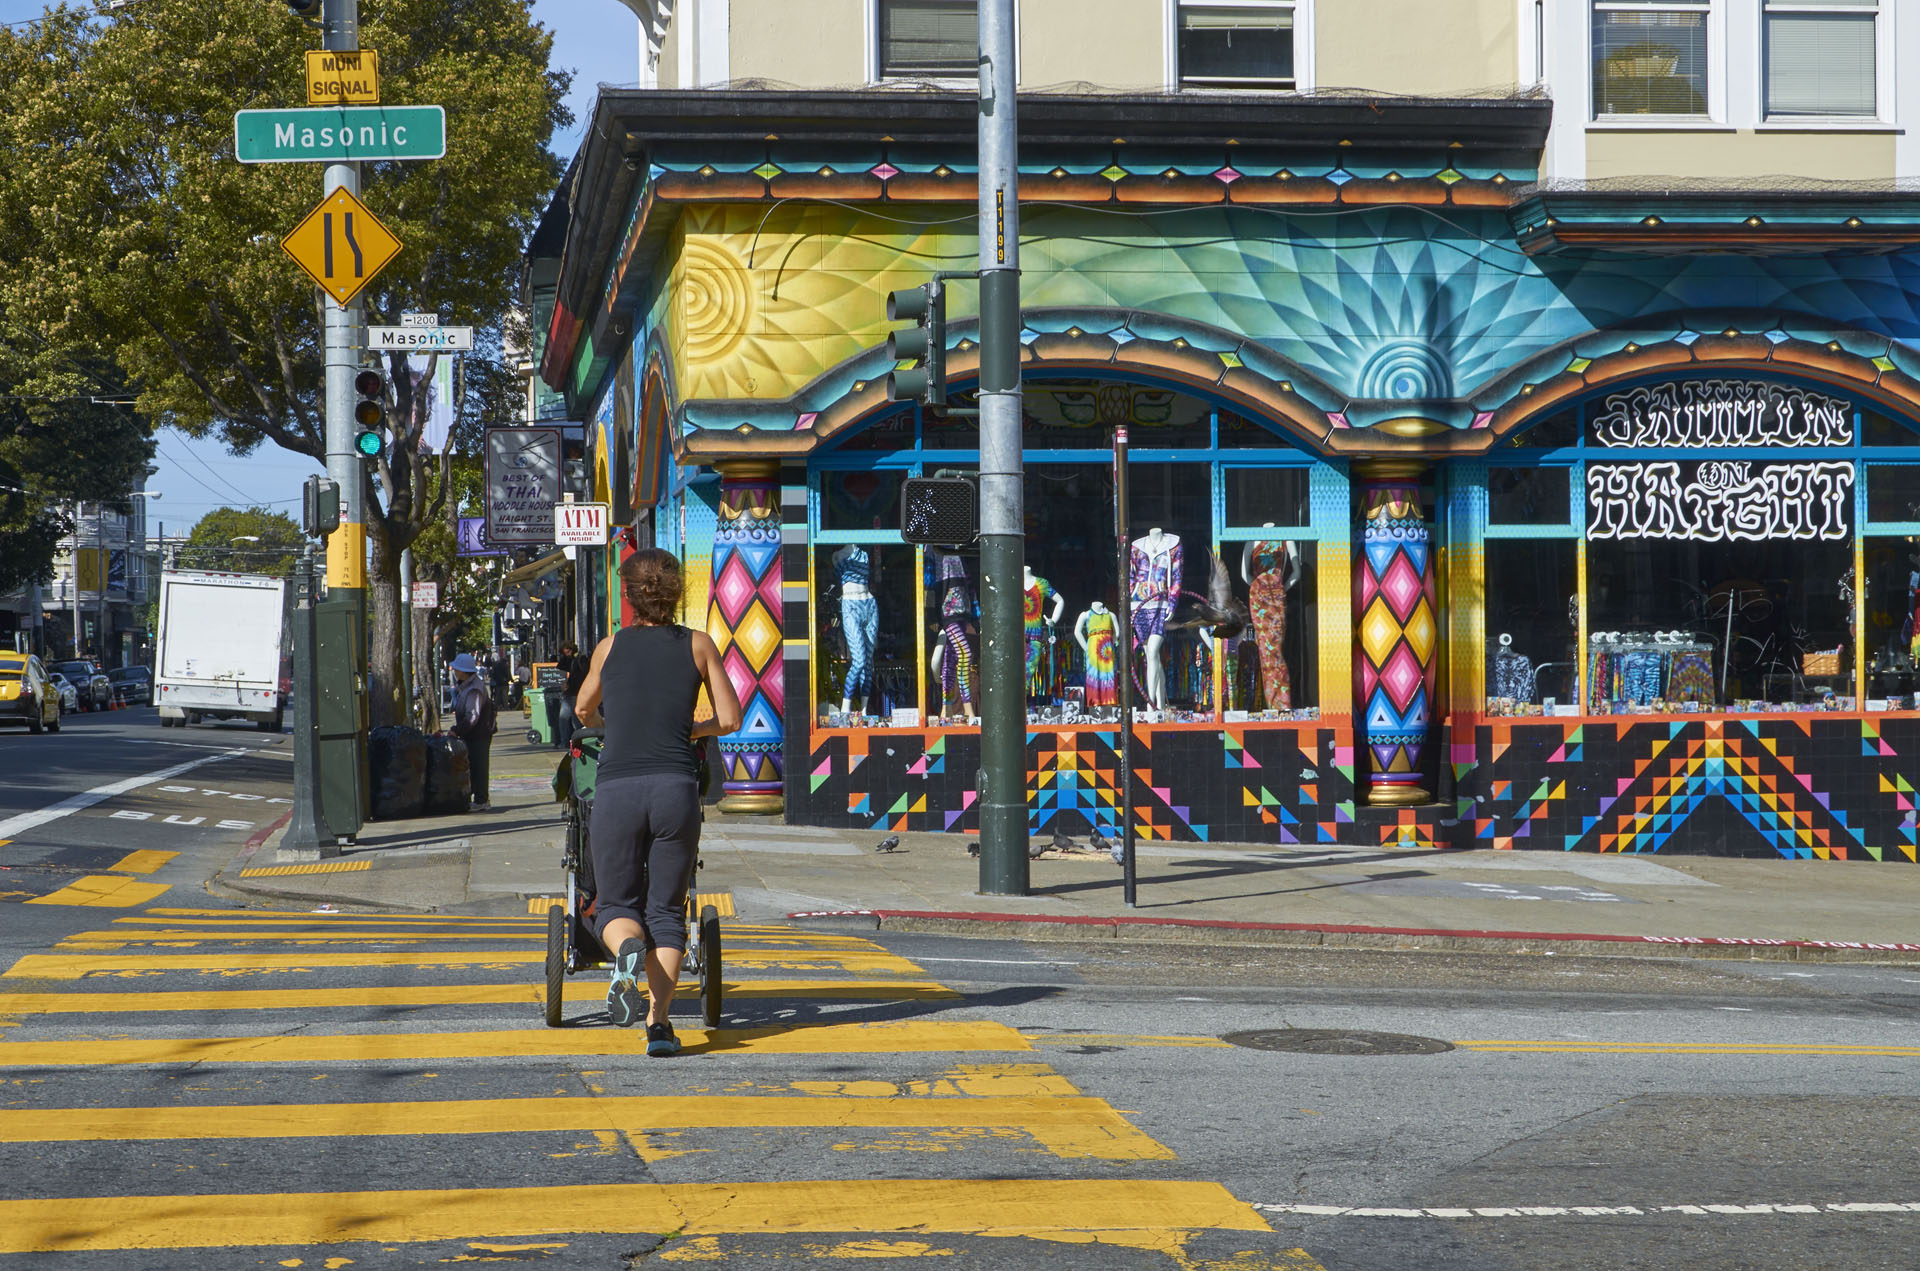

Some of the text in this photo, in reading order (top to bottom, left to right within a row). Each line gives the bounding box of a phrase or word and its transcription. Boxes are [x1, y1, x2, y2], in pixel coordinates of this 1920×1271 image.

[322, 57, 361, 71] MUNI
[313, 81, 373, 95] SIGNAL
[274, 122, 408, 148] Masonic
[413, 316, 435, 324] 1200
[382, 332, 456, 344] Masonic
[1593, 379, 1853, 448] JAMMIN
[502, 474, 527, 482] BEST
[506, 486, 543, 498] THAI
[492, 500, 525, 511] NOODLE
[1587, 461, 1855, 542] HAIGHT
[499, 514, 532, 522] HAIGHT
[562, 509, 600, 528] ATM
[495, 526, 509, 534] SAN
[108, 809, 257, 830] BUS
[1642, 936, 1704, 944] BUS
[1716, 937, 1787, 945] STOP
